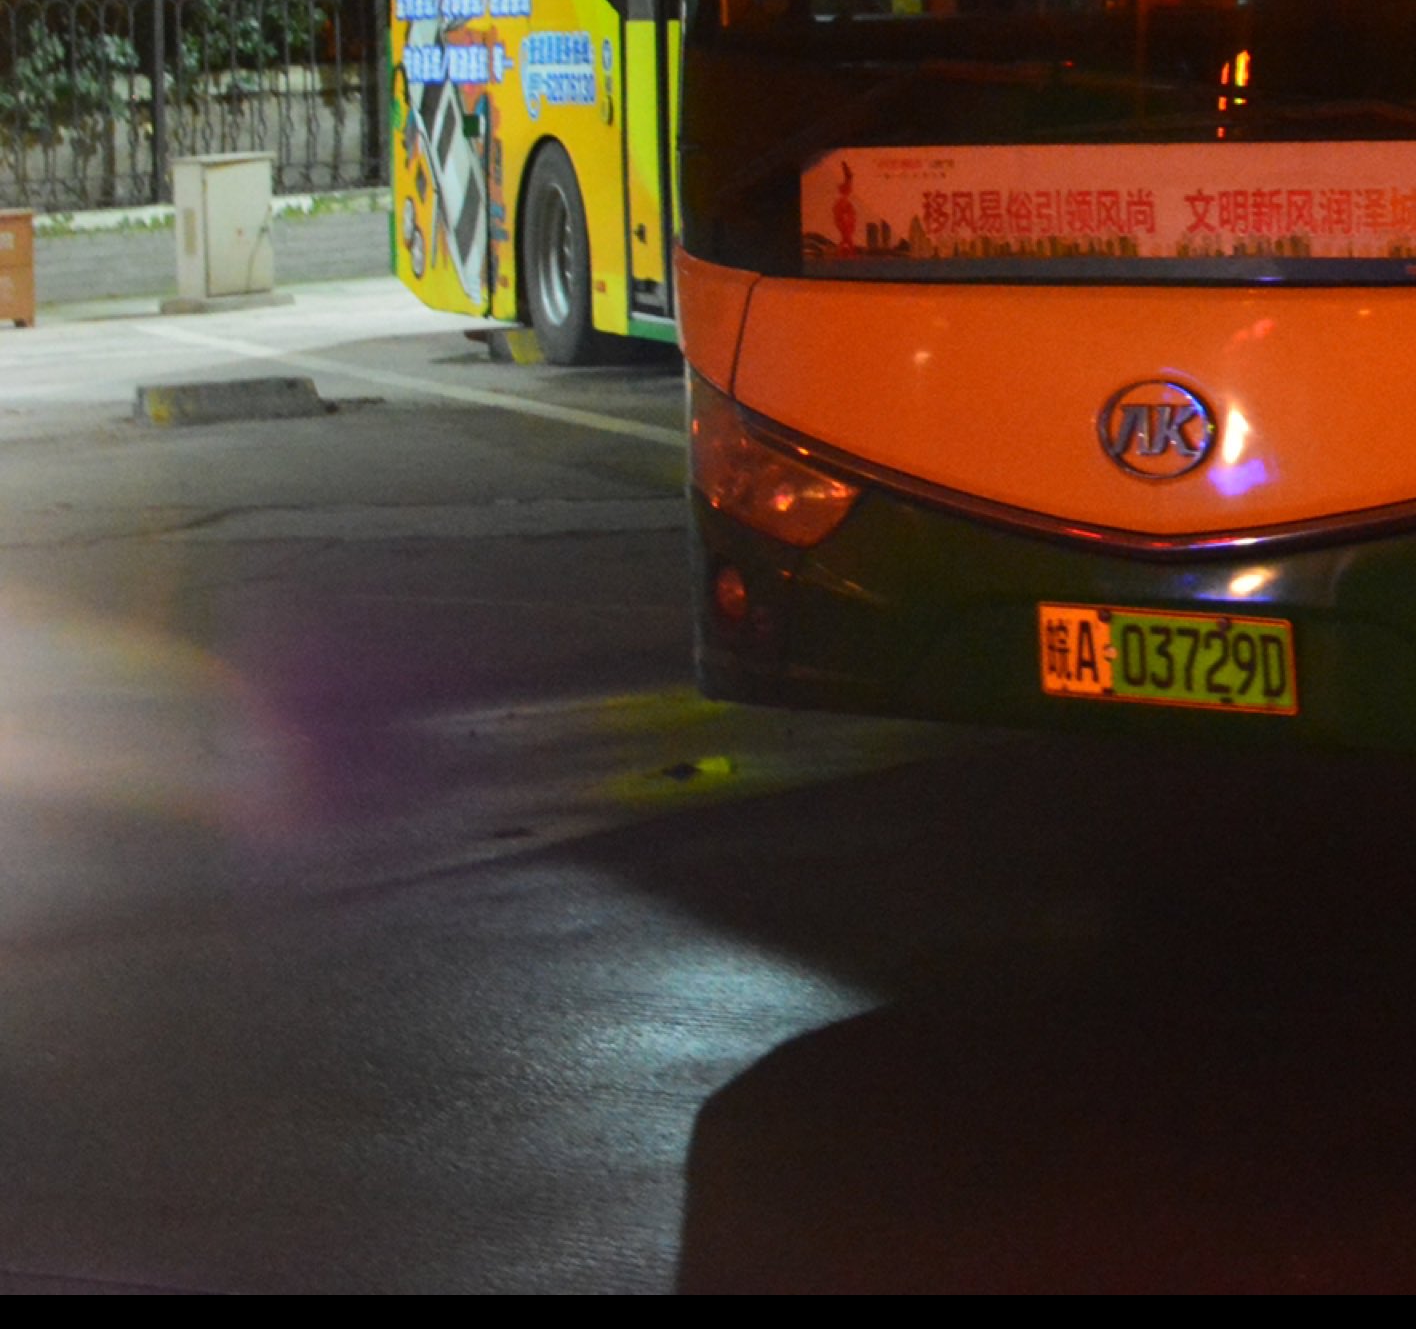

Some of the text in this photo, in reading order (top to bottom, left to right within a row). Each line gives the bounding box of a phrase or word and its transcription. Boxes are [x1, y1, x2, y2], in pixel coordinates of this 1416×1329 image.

[922, 189, 1156, 237] 移风易俗引领风尚
